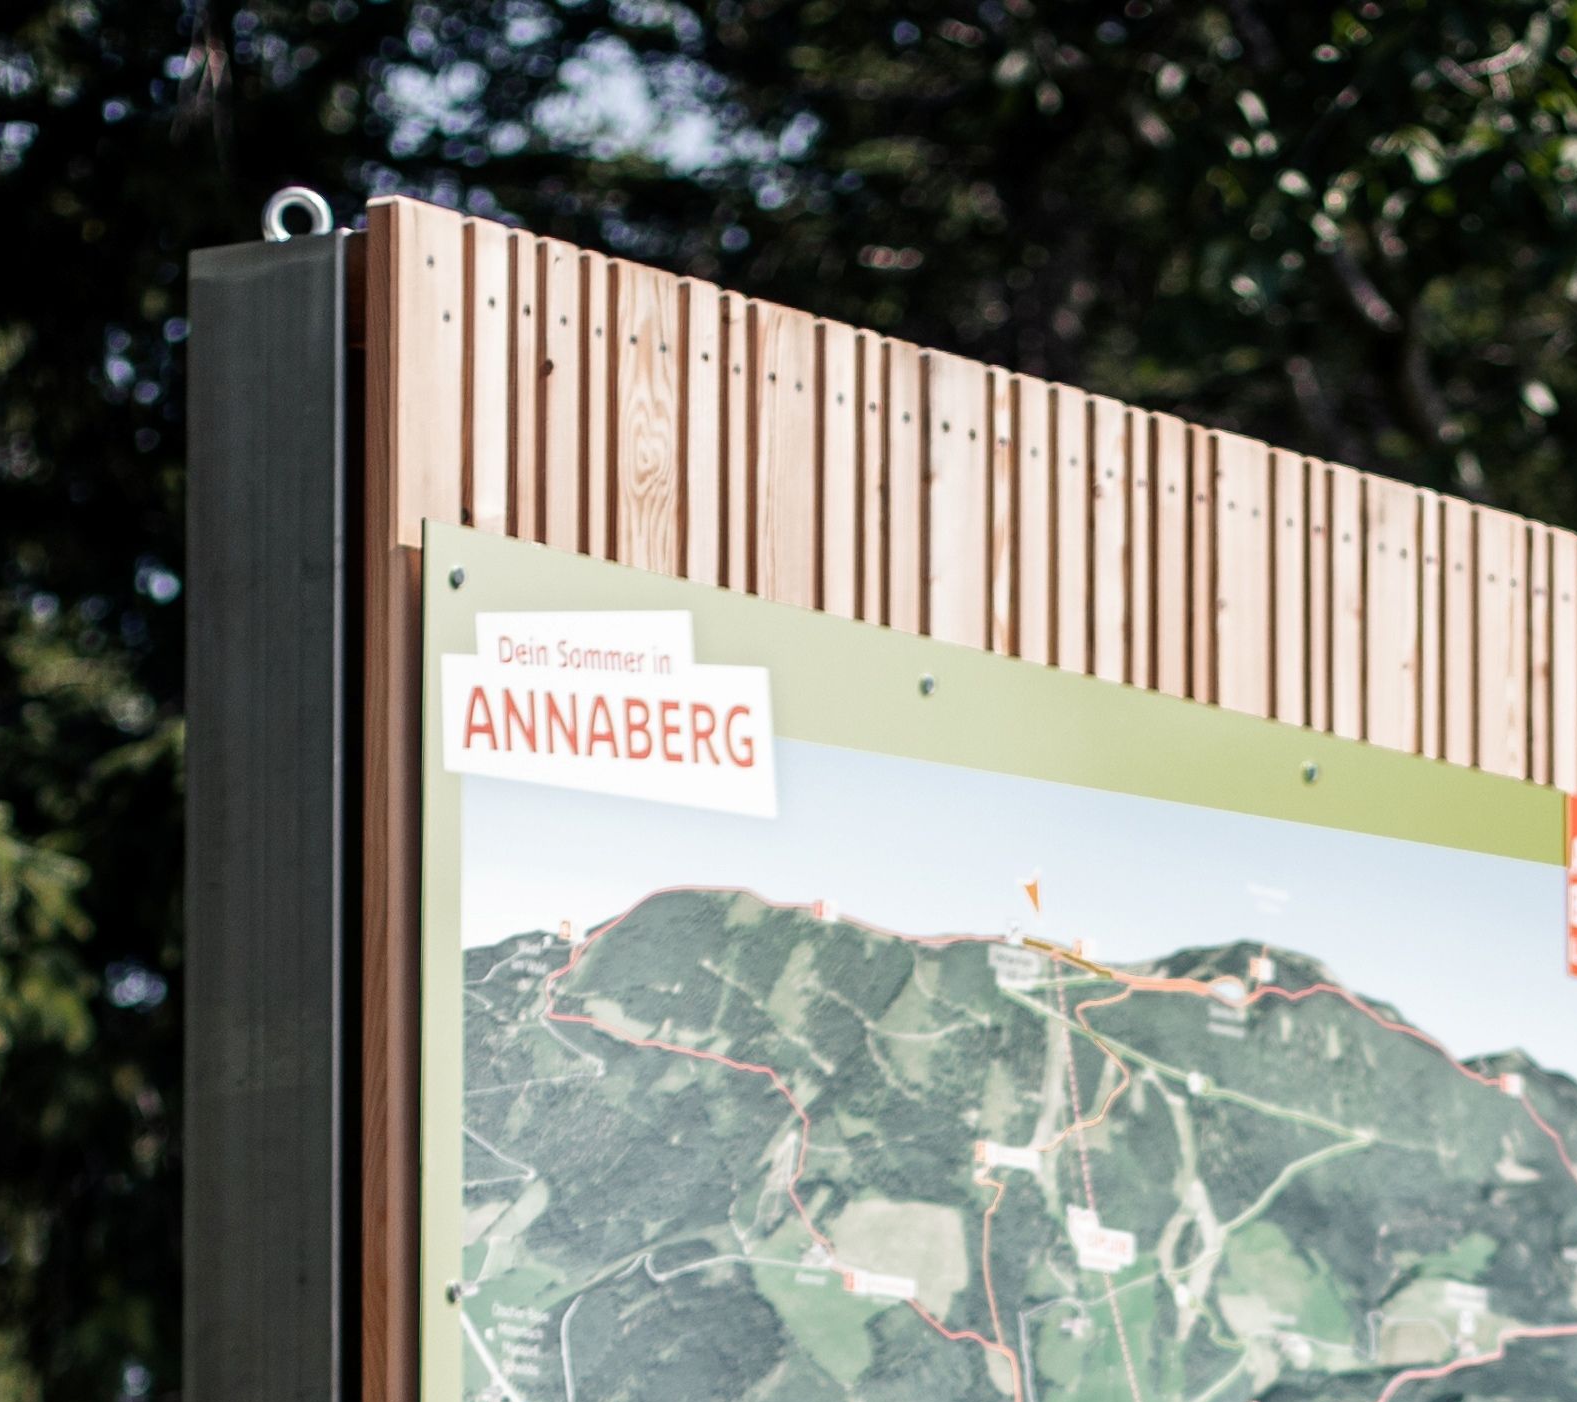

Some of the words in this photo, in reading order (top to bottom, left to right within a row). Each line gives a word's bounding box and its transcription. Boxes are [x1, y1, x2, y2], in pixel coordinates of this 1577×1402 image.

[498, 635, 549, 667] Dein
[557, 640, 645, 673] Sommer
[653, 646, 672, 675] in
[463, 685, 754, 768] ANNABERG
